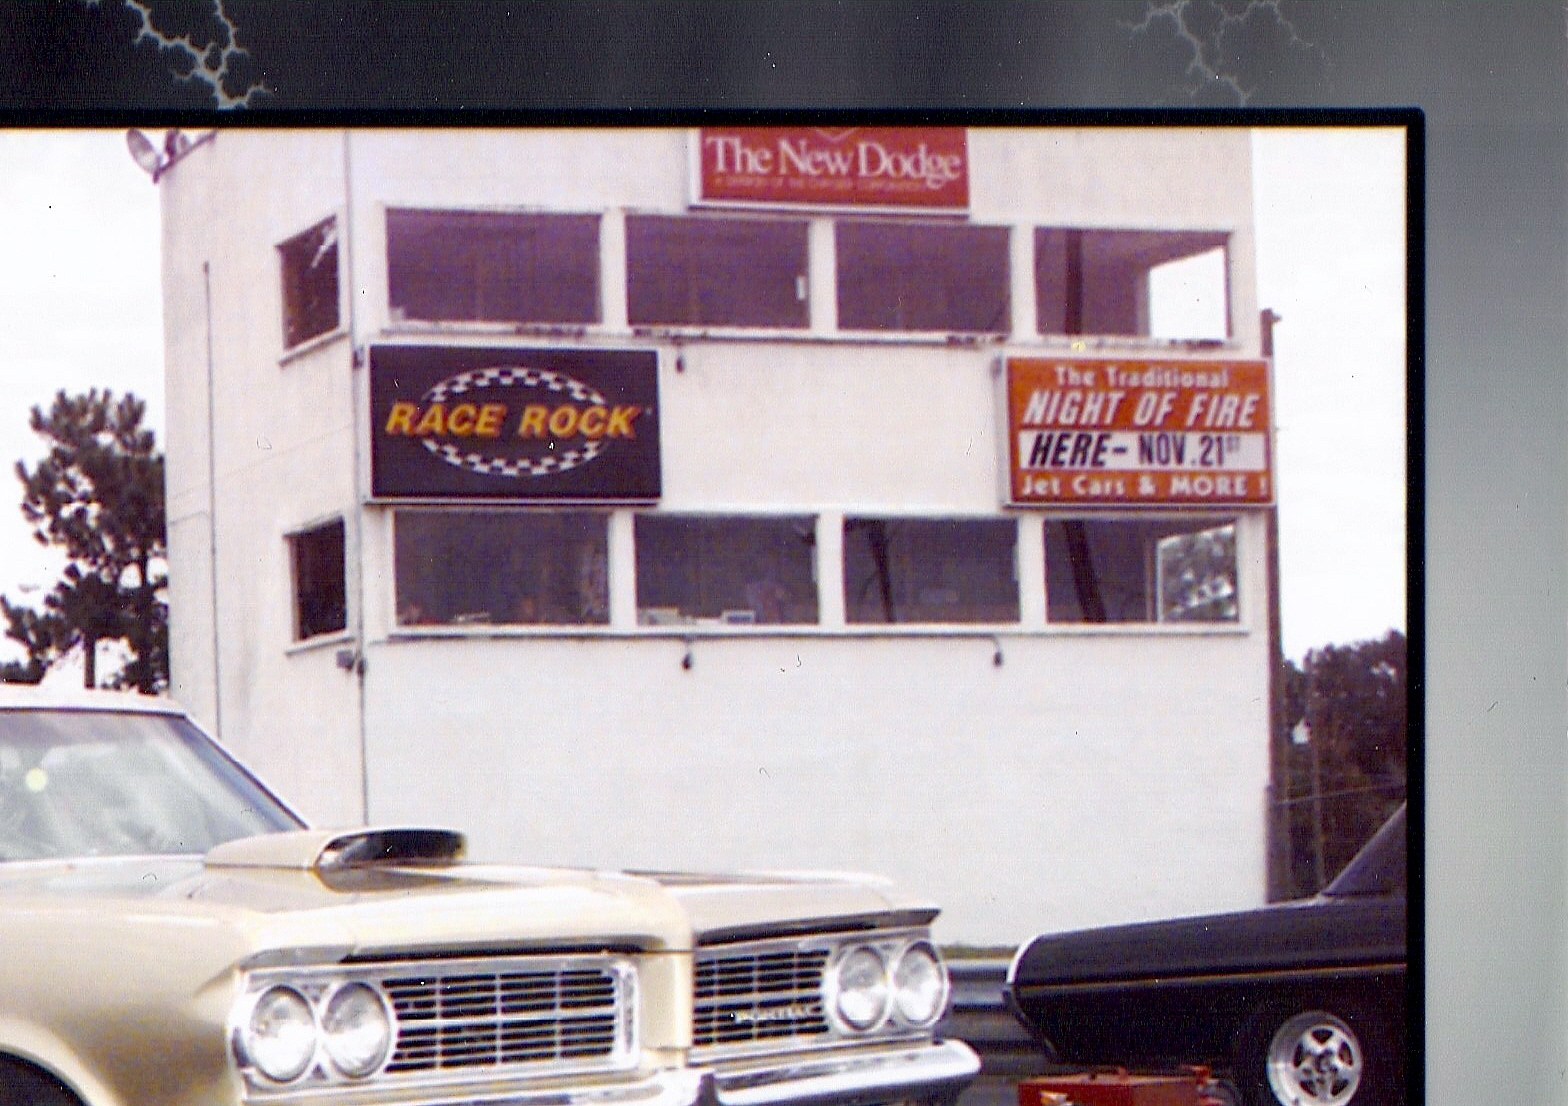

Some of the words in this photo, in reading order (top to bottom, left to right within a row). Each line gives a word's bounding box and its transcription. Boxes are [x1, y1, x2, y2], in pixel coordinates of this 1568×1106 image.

[706, 136, 772, 176] The
[778, 138, 853, 176] New
[857, 142, 962, 190] Dodge
[1054, 366, 1095, 387] The
[1106, 366, 1230, 388] Traditional
[384, 401, 508, 437] RACE
[518, 403, 642, 439] ROCK
[1021, 390, 1124, 426] NIGHT
[1133, 392, 1177, 426] OF
[1185, 394, 1260, 428] FIRE
[1022, 475, 1060, 496] Jet
[1072, 475, 1125, 496] Cars
[1138, 475, 1156, 496] &
[1169, 476, 1248, 496] MORE
